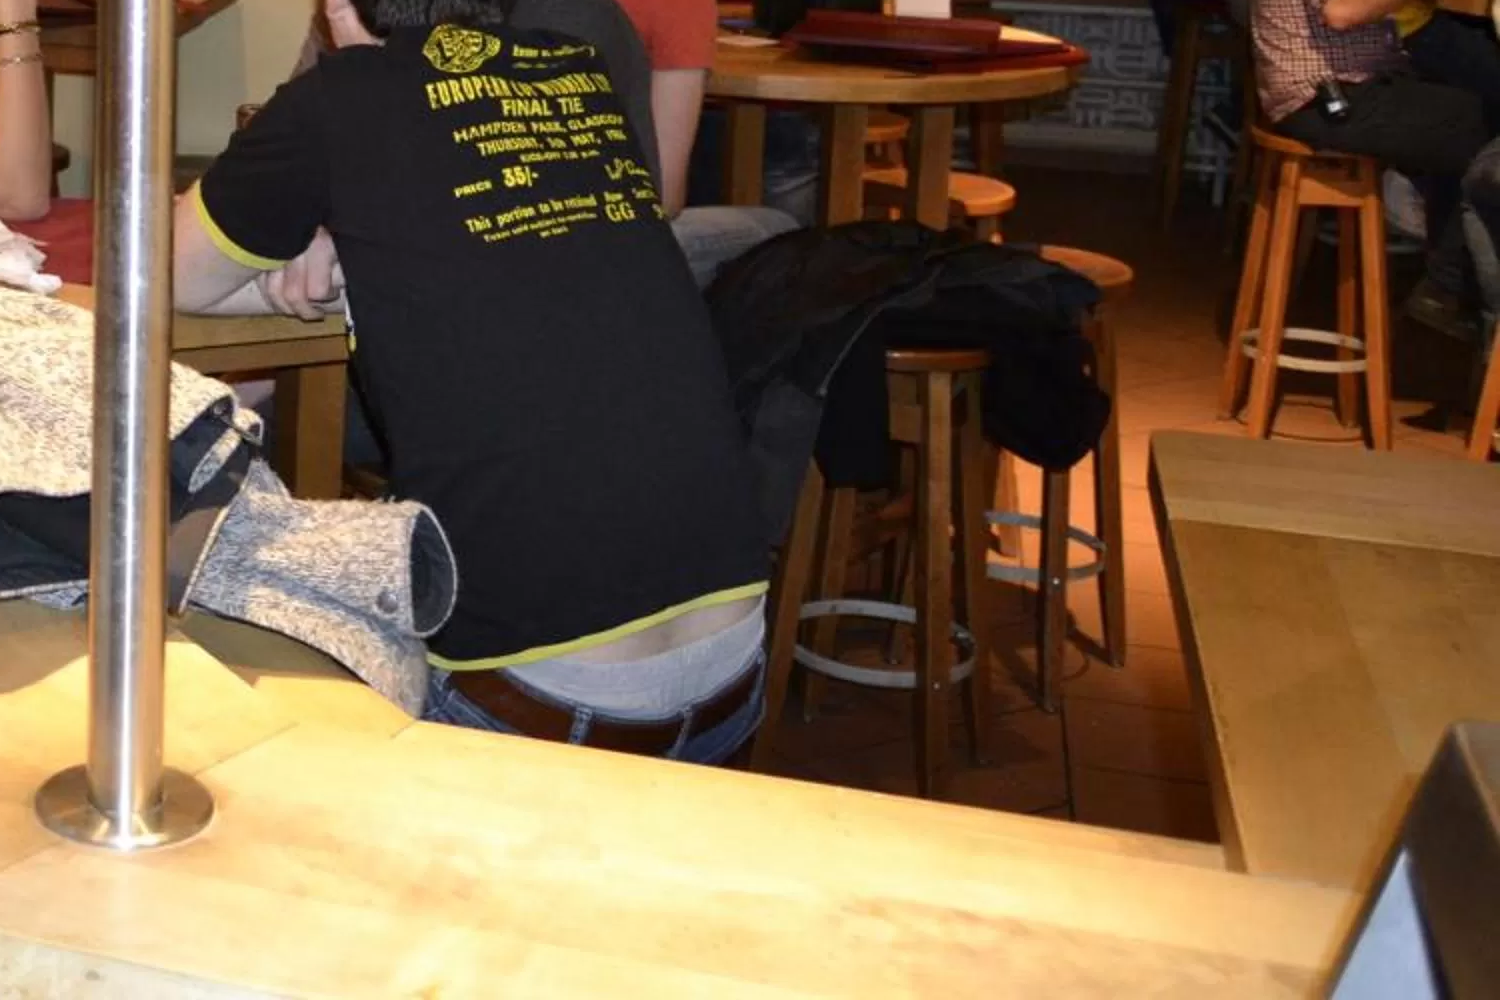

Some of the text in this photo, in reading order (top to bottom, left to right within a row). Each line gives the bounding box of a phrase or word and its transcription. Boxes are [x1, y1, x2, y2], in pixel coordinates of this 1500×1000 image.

[500, 96, 586, 117] FINAL TIE
[452, 120, 528, 144] HAMPDEN
[496, 205, 537, 228] portion
[604, 200, 637, 223] GG
